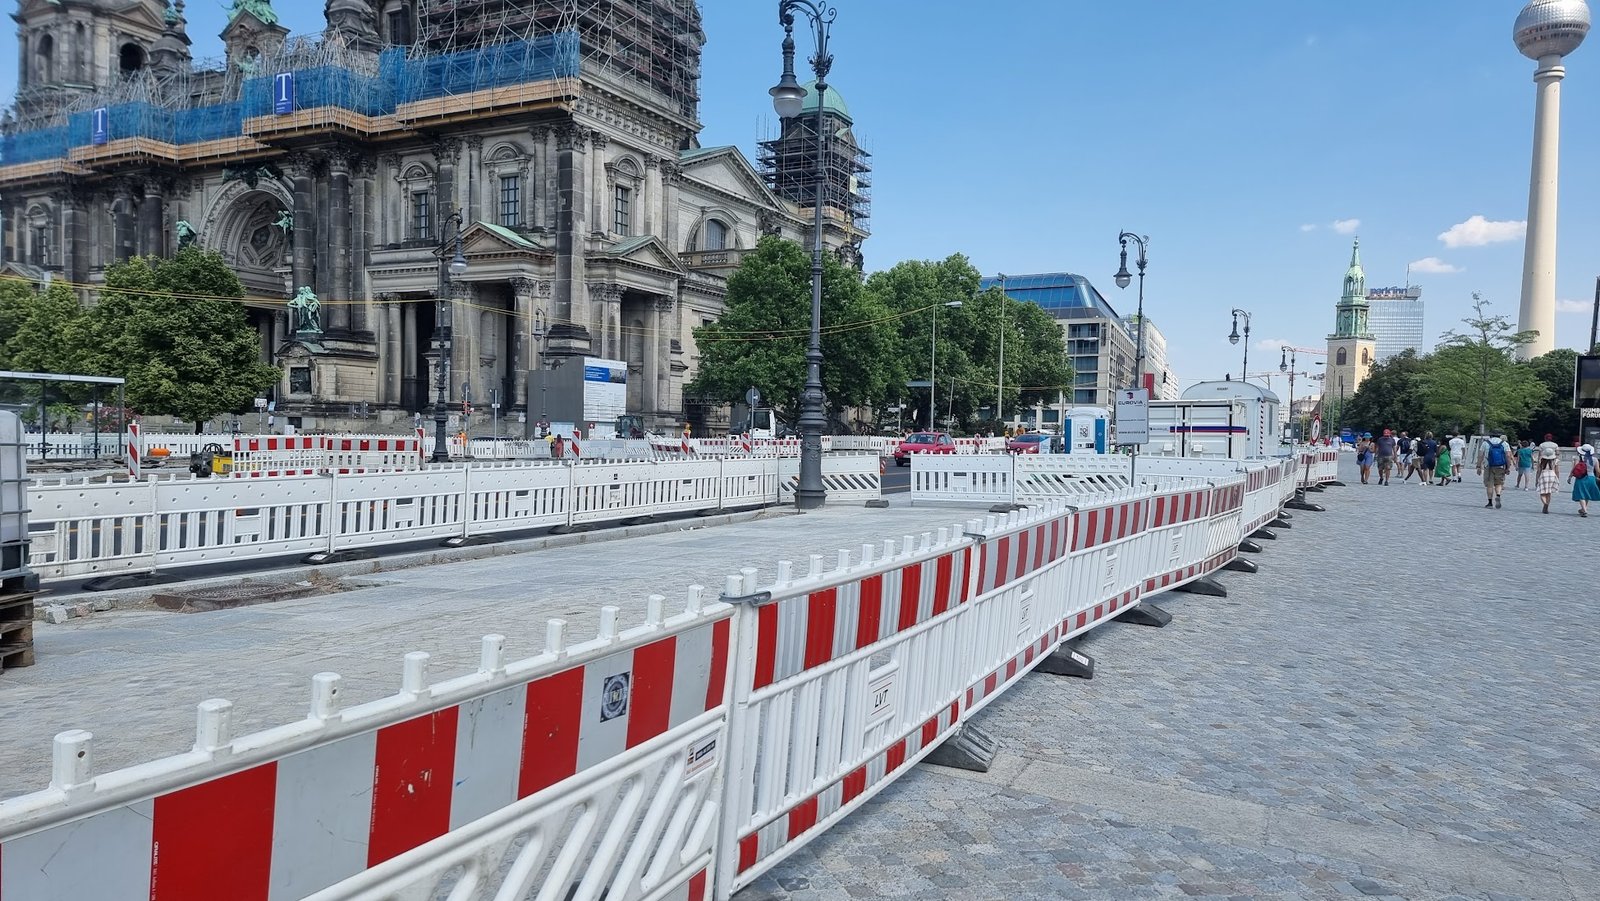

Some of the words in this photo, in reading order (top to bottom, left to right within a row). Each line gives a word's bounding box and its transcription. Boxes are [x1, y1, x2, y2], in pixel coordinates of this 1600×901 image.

[276, 73, 292, 102] T
[94, 107, 106, 133] T
[874, 688, 889, 708] LVT
